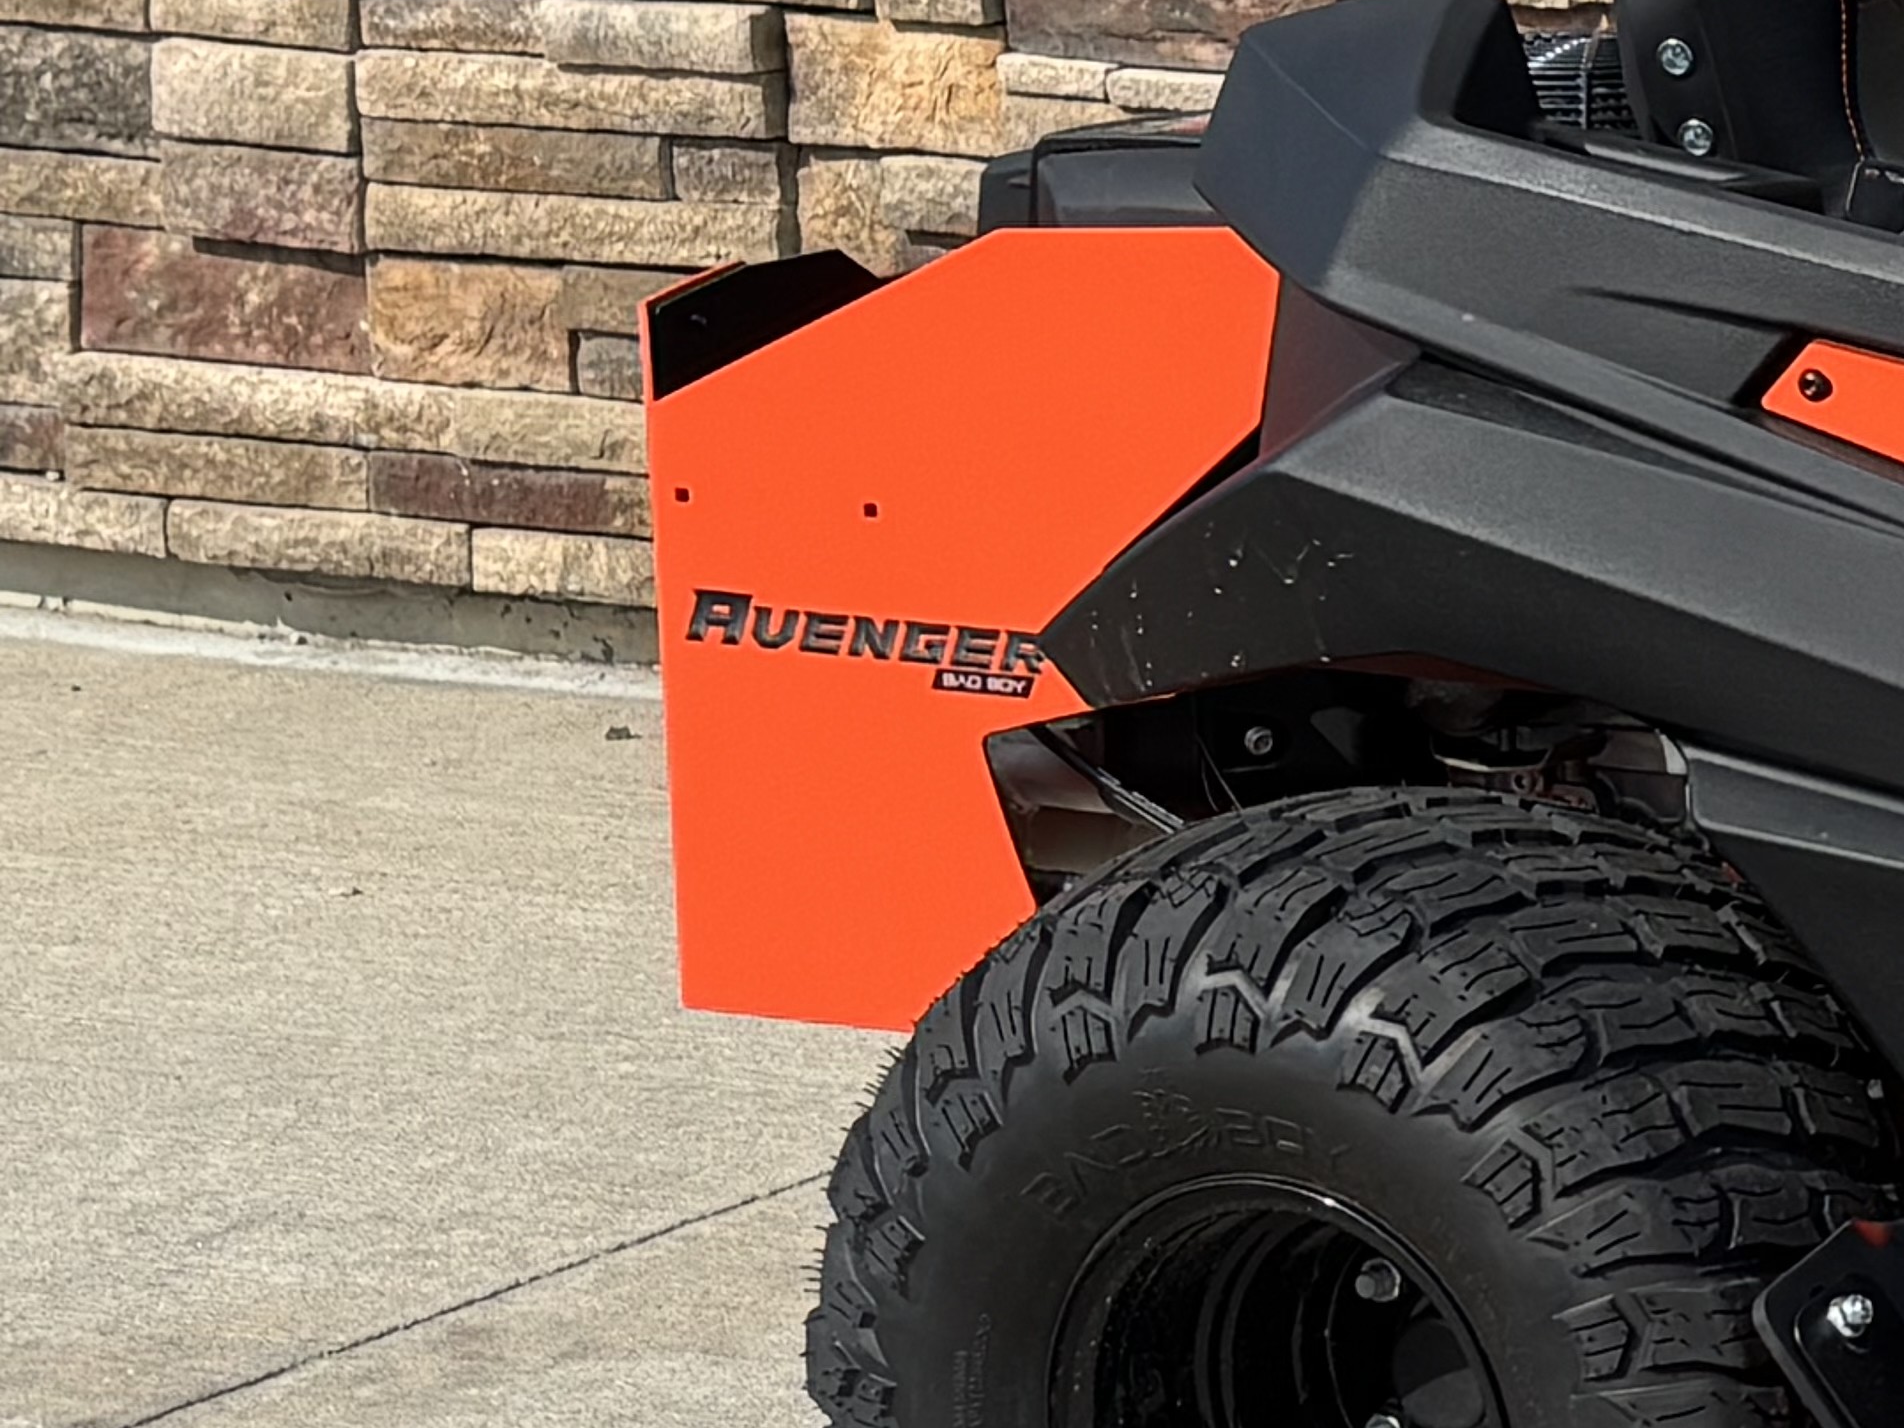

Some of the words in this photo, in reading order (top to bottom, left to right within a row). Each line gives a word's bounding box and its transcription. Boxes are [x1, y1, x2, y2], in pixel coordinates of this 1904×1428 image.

[686, 588, 1046, 674] AVENGER
[941, 672, 980, 691] BAD
[986, 676, 1026, 694] BOY
